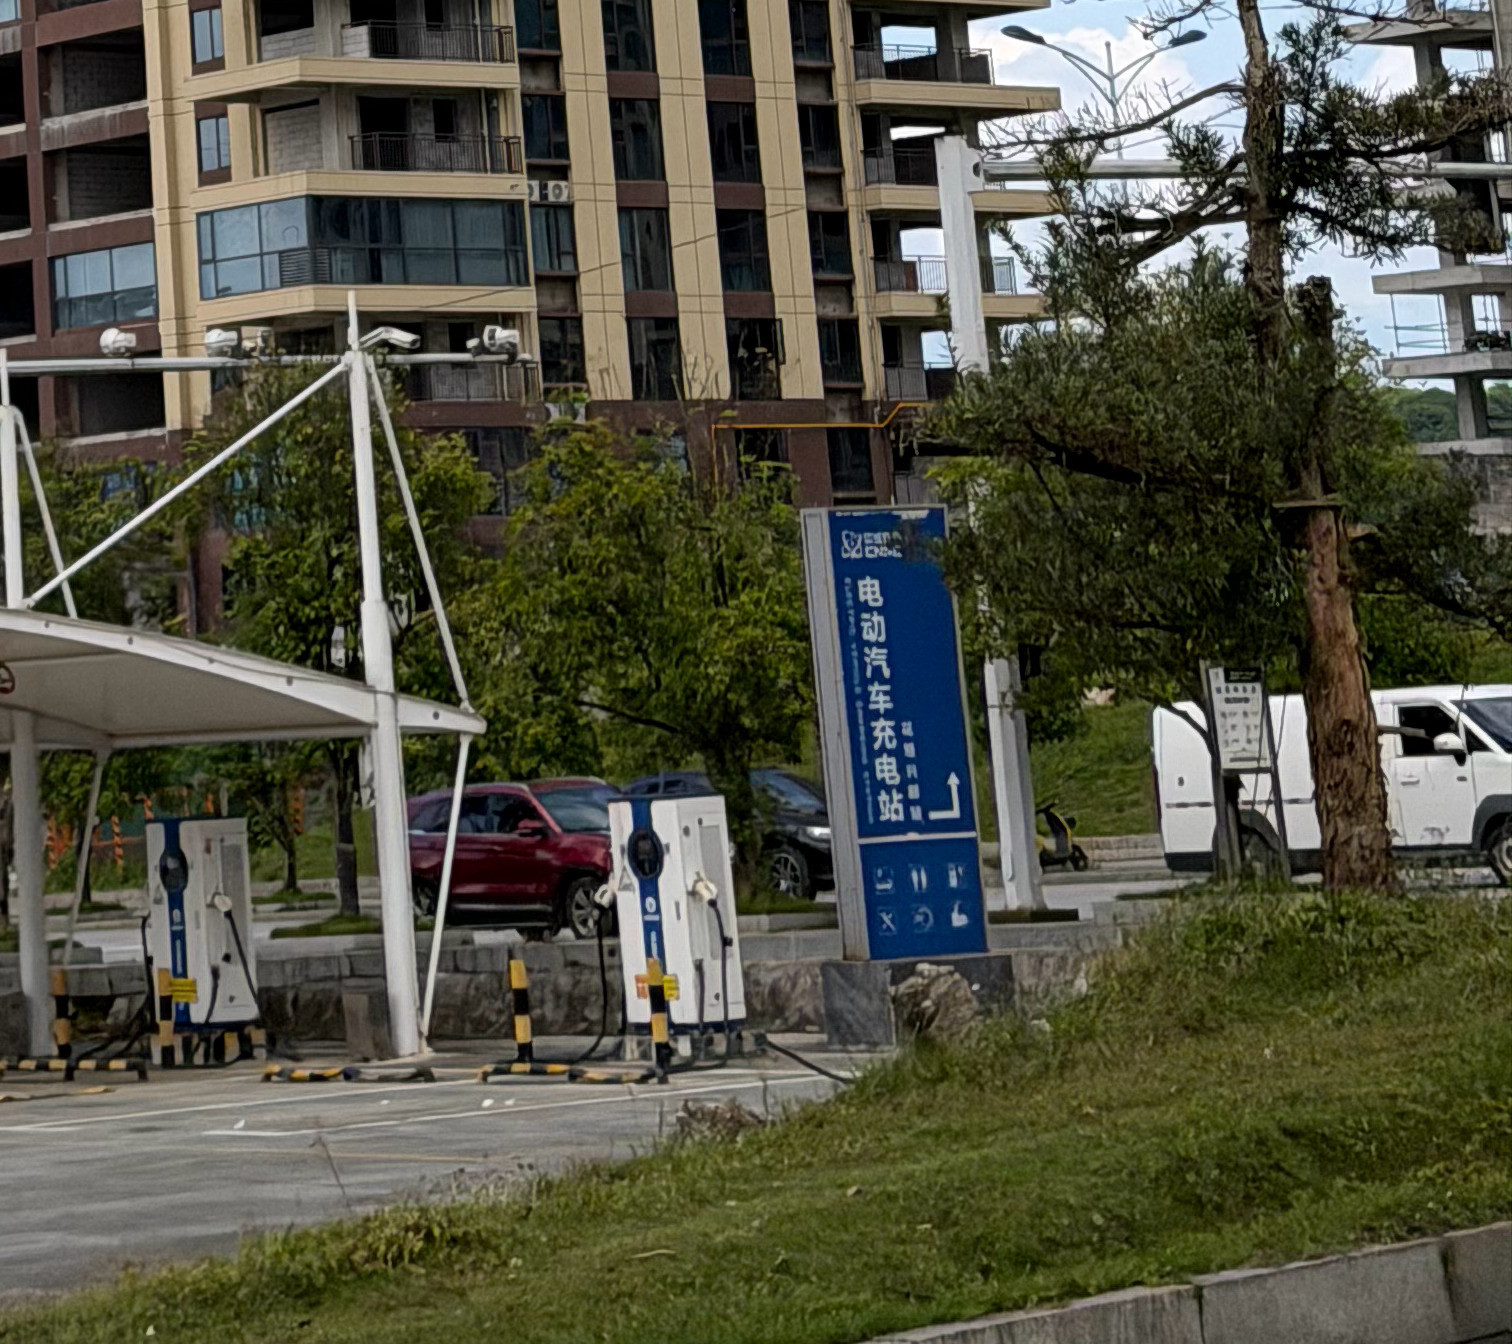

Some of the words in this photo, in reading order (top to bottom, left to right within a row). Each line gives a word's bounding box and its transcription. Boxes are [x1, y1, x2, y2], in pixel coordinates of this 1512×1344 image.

[857, 576, 905, 822] 电动汽车充电站
